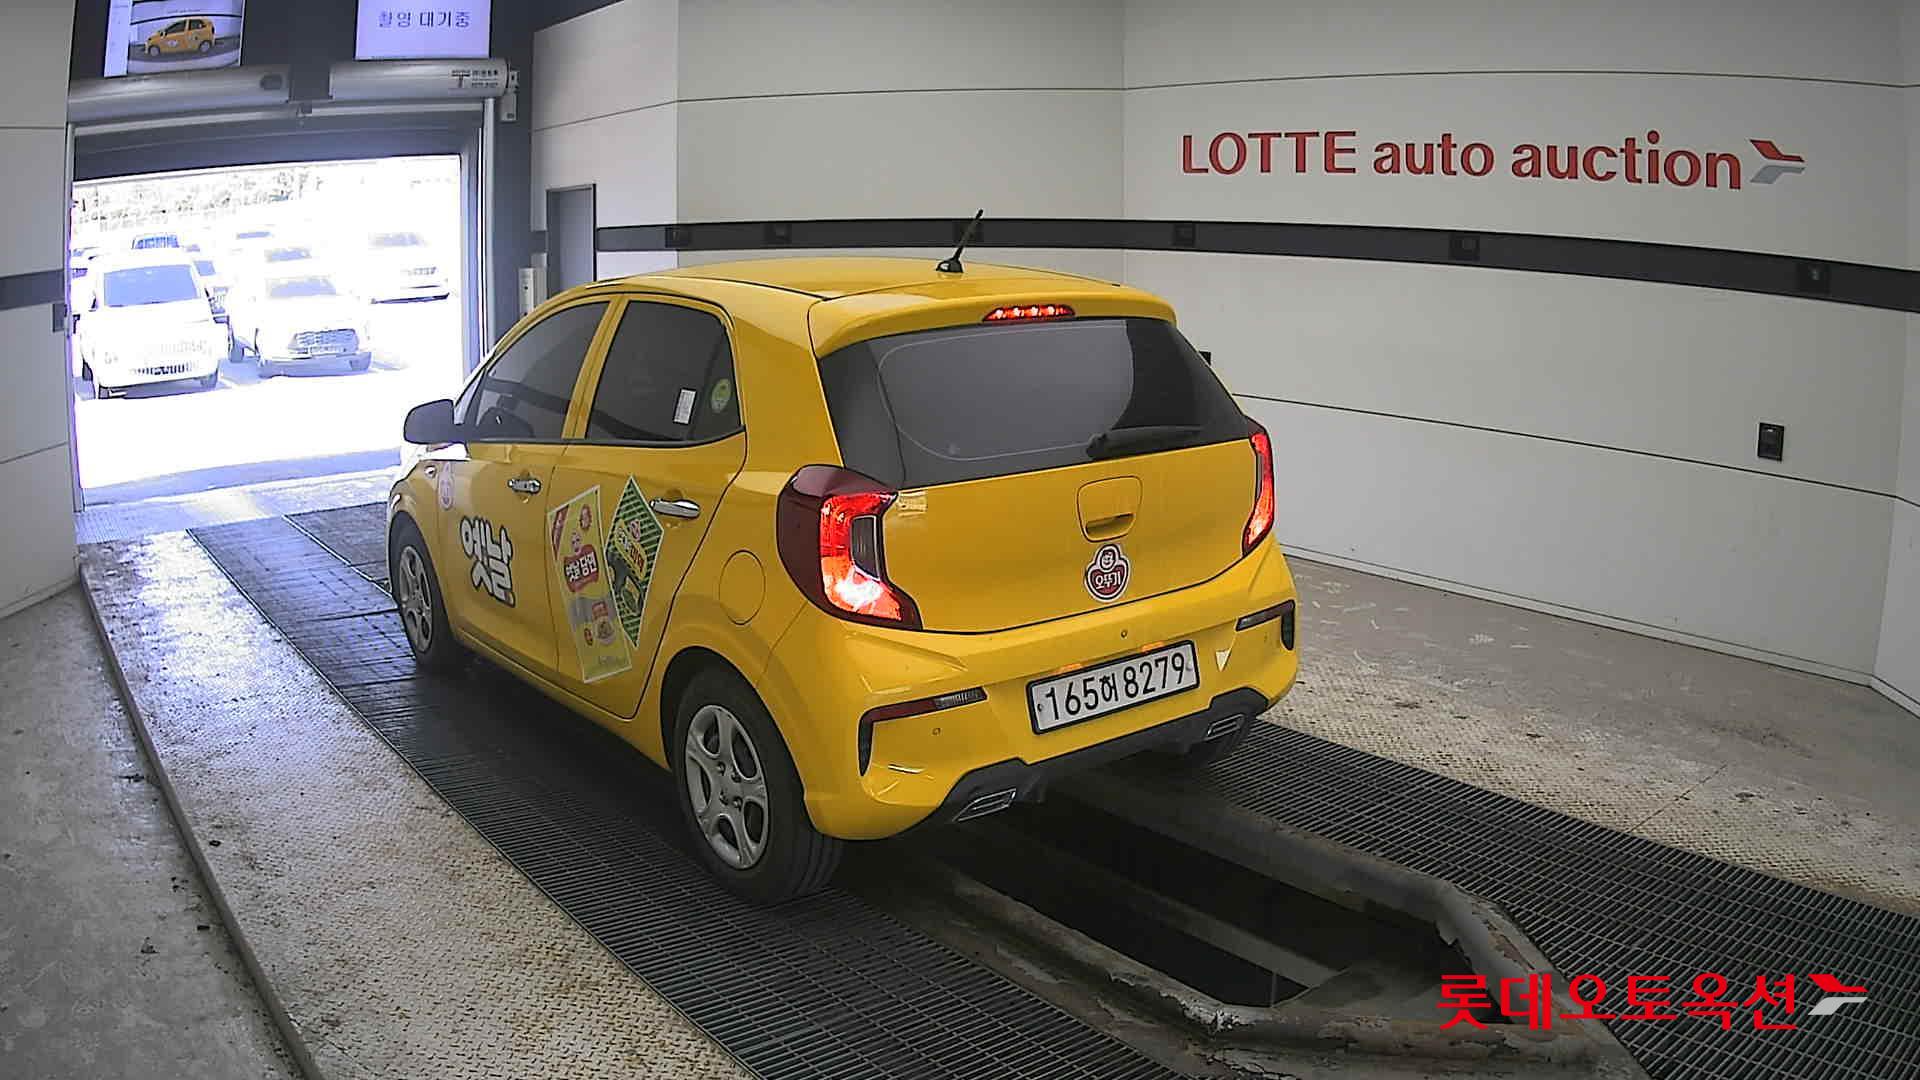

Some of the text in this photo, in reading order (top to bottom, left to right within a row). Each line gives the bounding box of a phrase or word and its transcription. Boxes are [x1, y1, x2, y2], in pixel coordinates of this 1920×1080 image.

[419, 10, 471, 28] 대기중
[1181, 130, 1741, 190] LOTTE auto auction
[460, 515, 515, 608] 옛날
[579, 551, 598, 577] 당면
[1095, 570, 1121, 590] 오뚜기
[1045, 652, 1185, 720] 165허 8279
